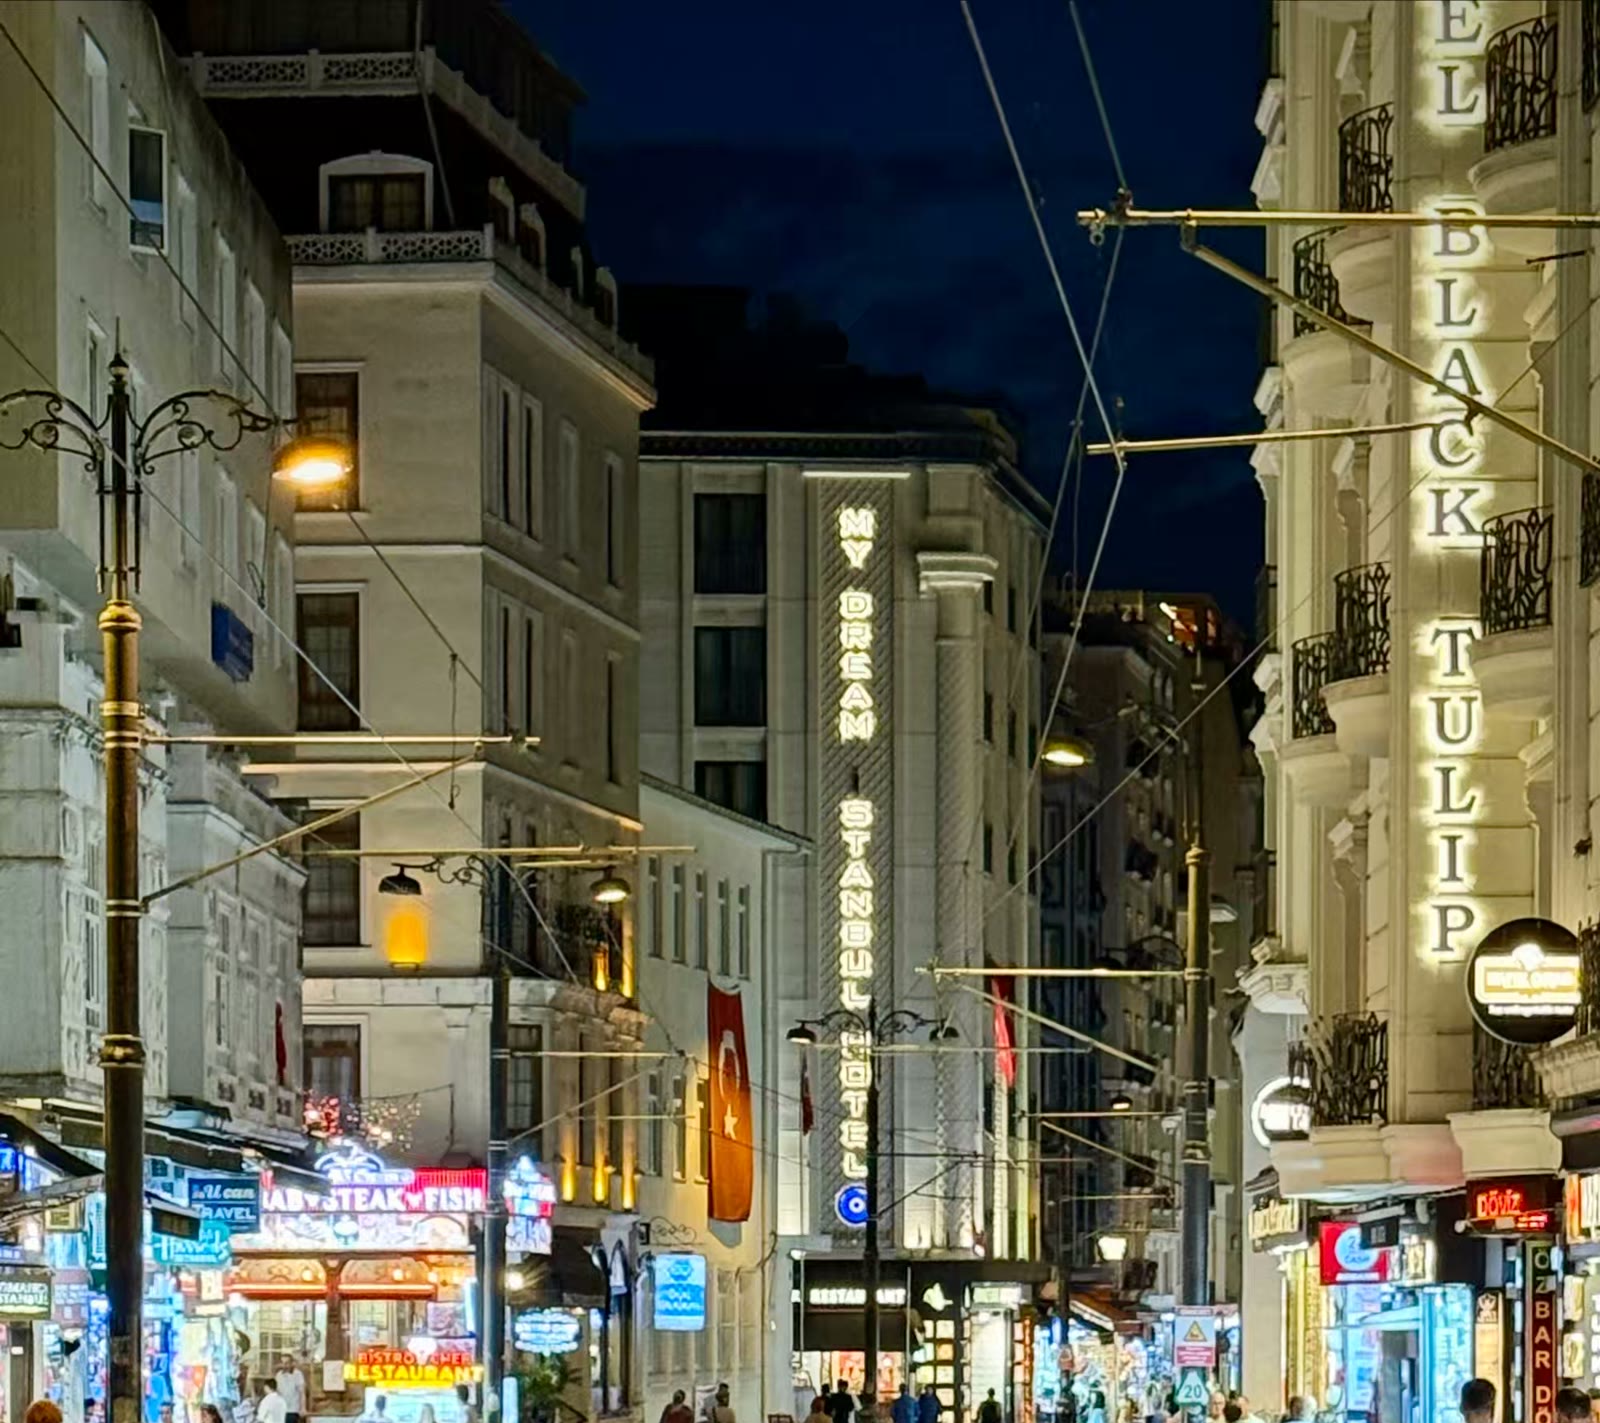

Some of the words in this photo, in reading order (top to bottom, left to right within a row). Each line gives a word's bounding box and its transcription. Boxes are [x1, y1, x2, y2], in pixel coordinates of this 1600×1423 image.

[1426, 208, 1484, 537] BLACK
[839, 508, 874, 568] MY
[839, 591, 874, 742] DREAM
[1429, 627, 1479, 952] TULIP
[840, 1029, 872, 1179] HOTEL
[192, 1203, 256, 1220] TRAVEL
[323, 1186, 407, 1211] STEAK
[424, 1187, 484, 1212] FISH
[343, 1364, 484, 1382] RESTAURANT
[1184, 1384, 1203, 1399] 20
